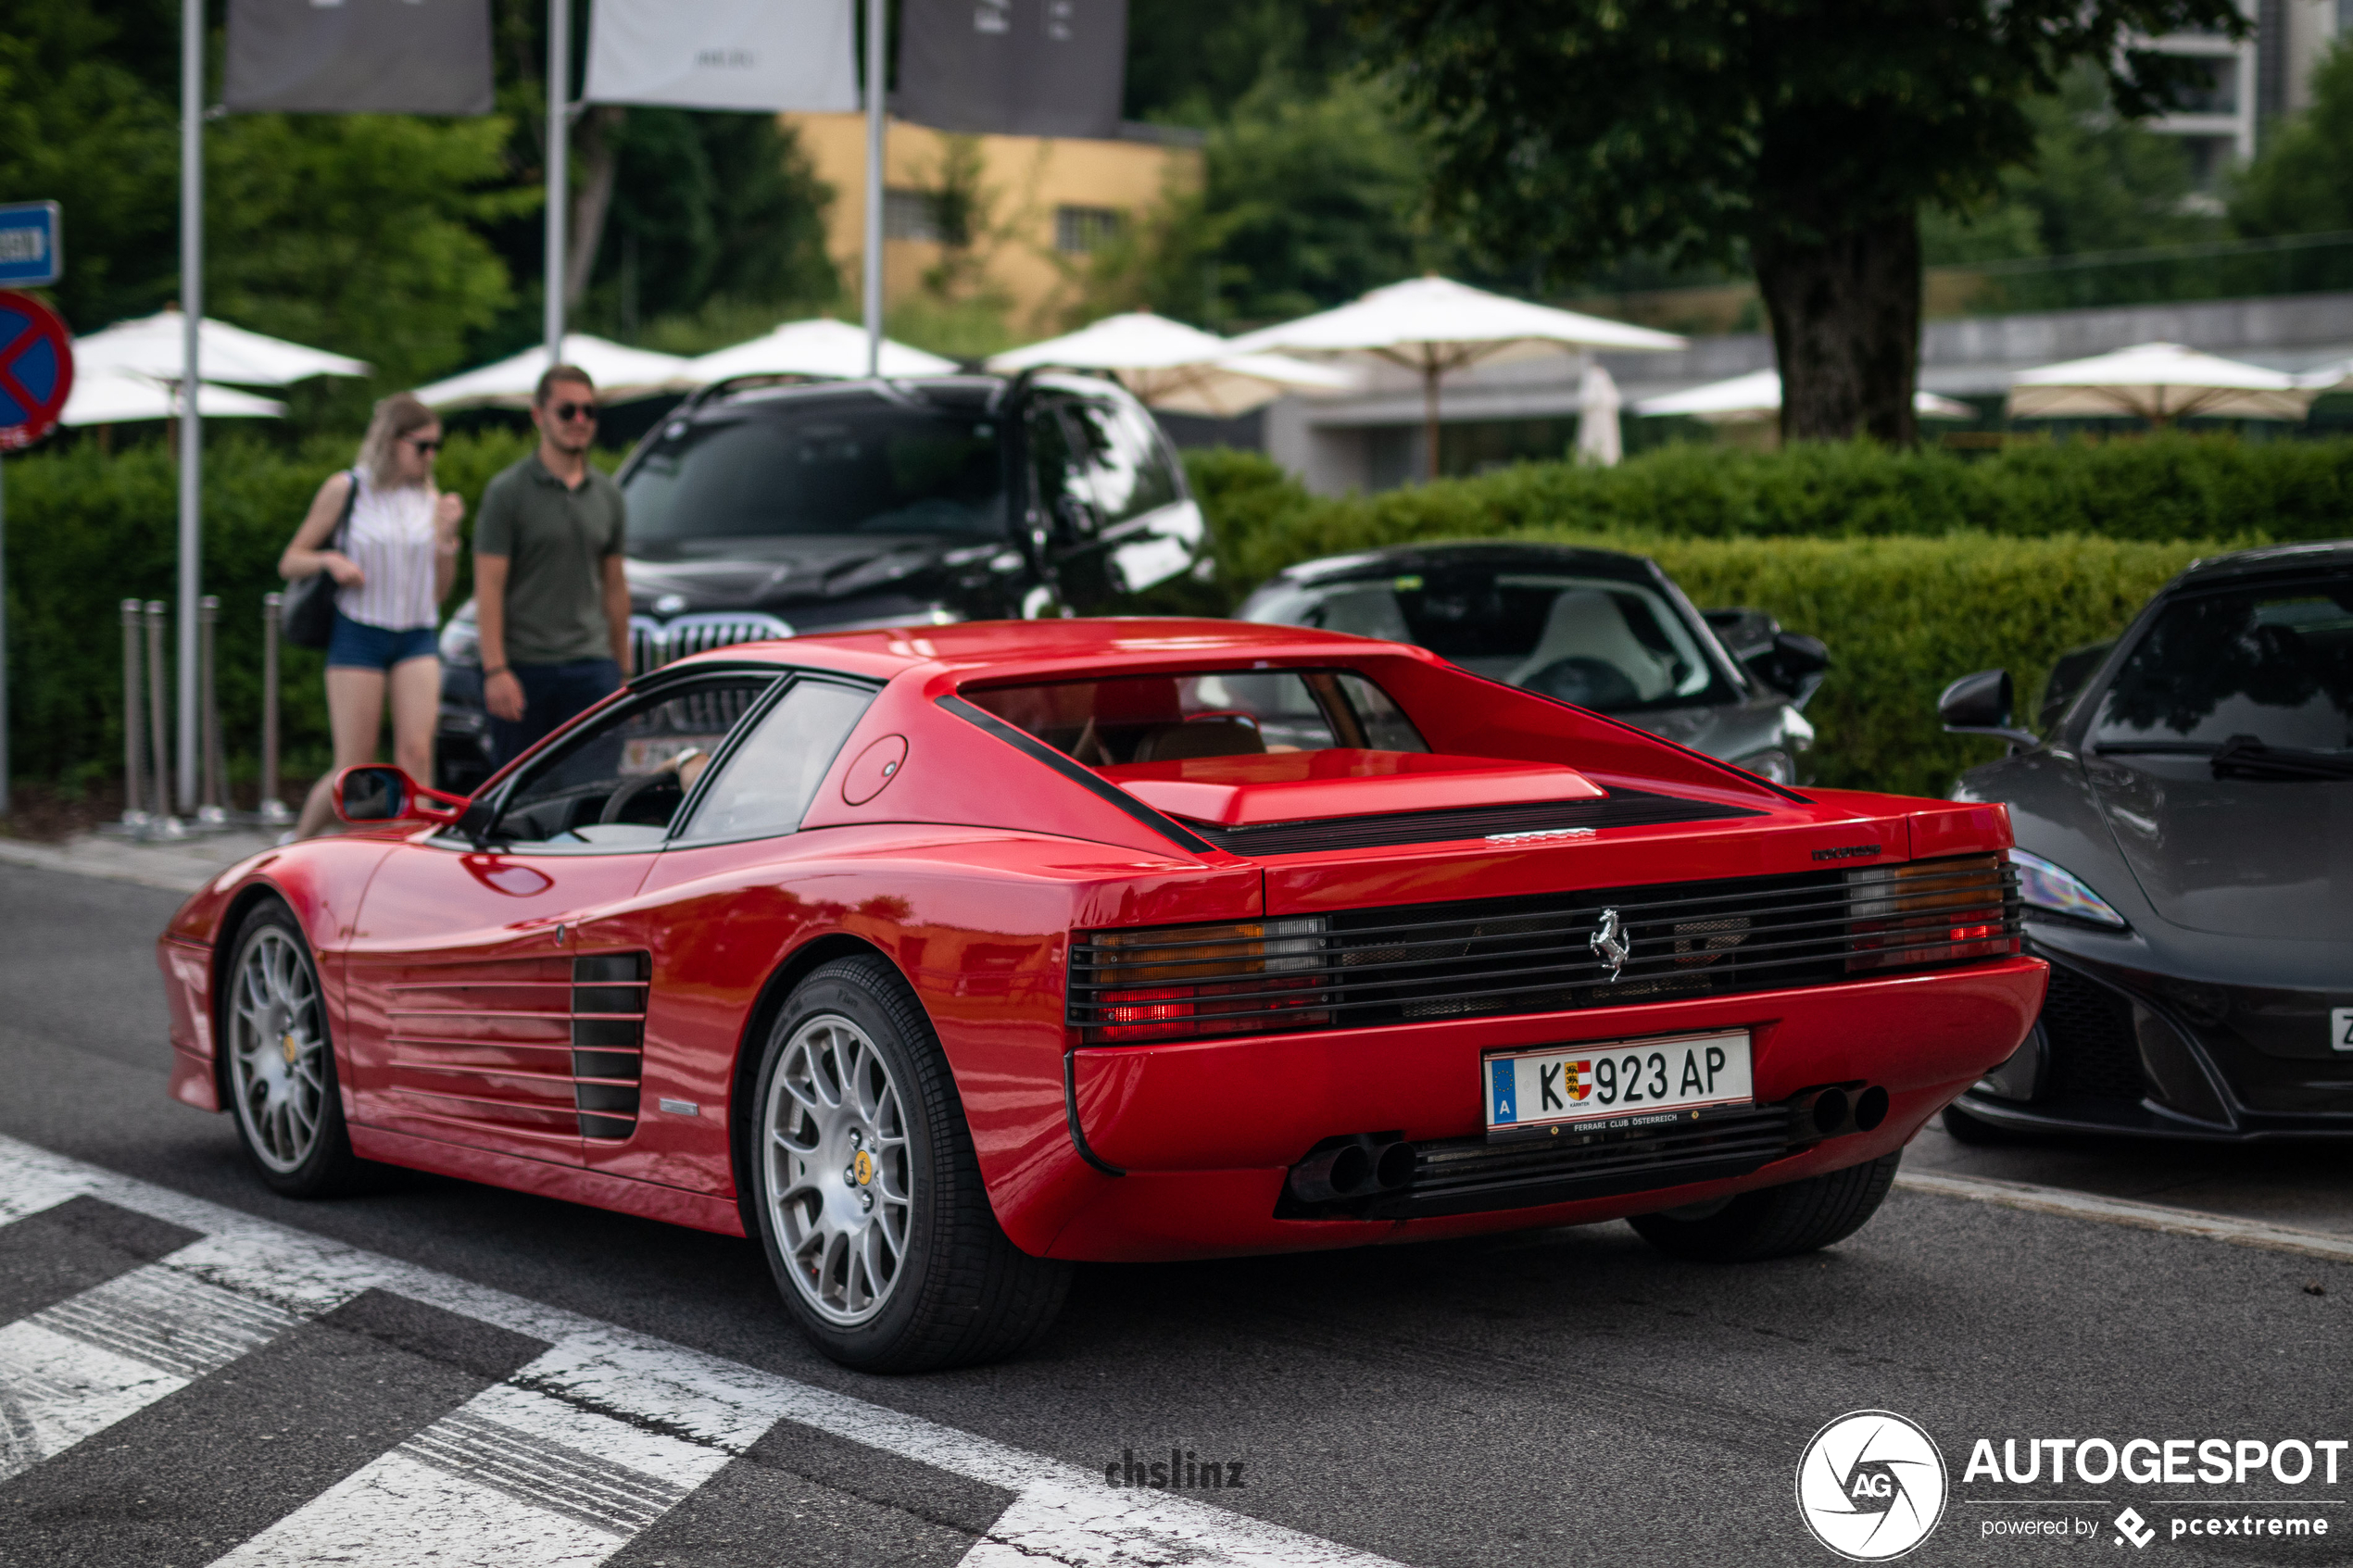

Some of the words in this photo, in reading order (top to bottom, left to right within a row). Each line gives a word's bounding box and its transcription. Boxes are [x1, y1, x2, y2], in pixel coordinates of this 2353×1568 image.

[1540, 1061, 1564, 1111] K
[1595, 1052, 1668, 1105] 923
[1680, 1046, 1726, 1097] AP
[1499, 1099, 1511, 1115] A
[1574, 1121, 1607, 1133] FERRARI
[1610, 1119, 1629, 1129] CLUB
[1632, 1112, 1678, 1126] ÖSTERREICH
